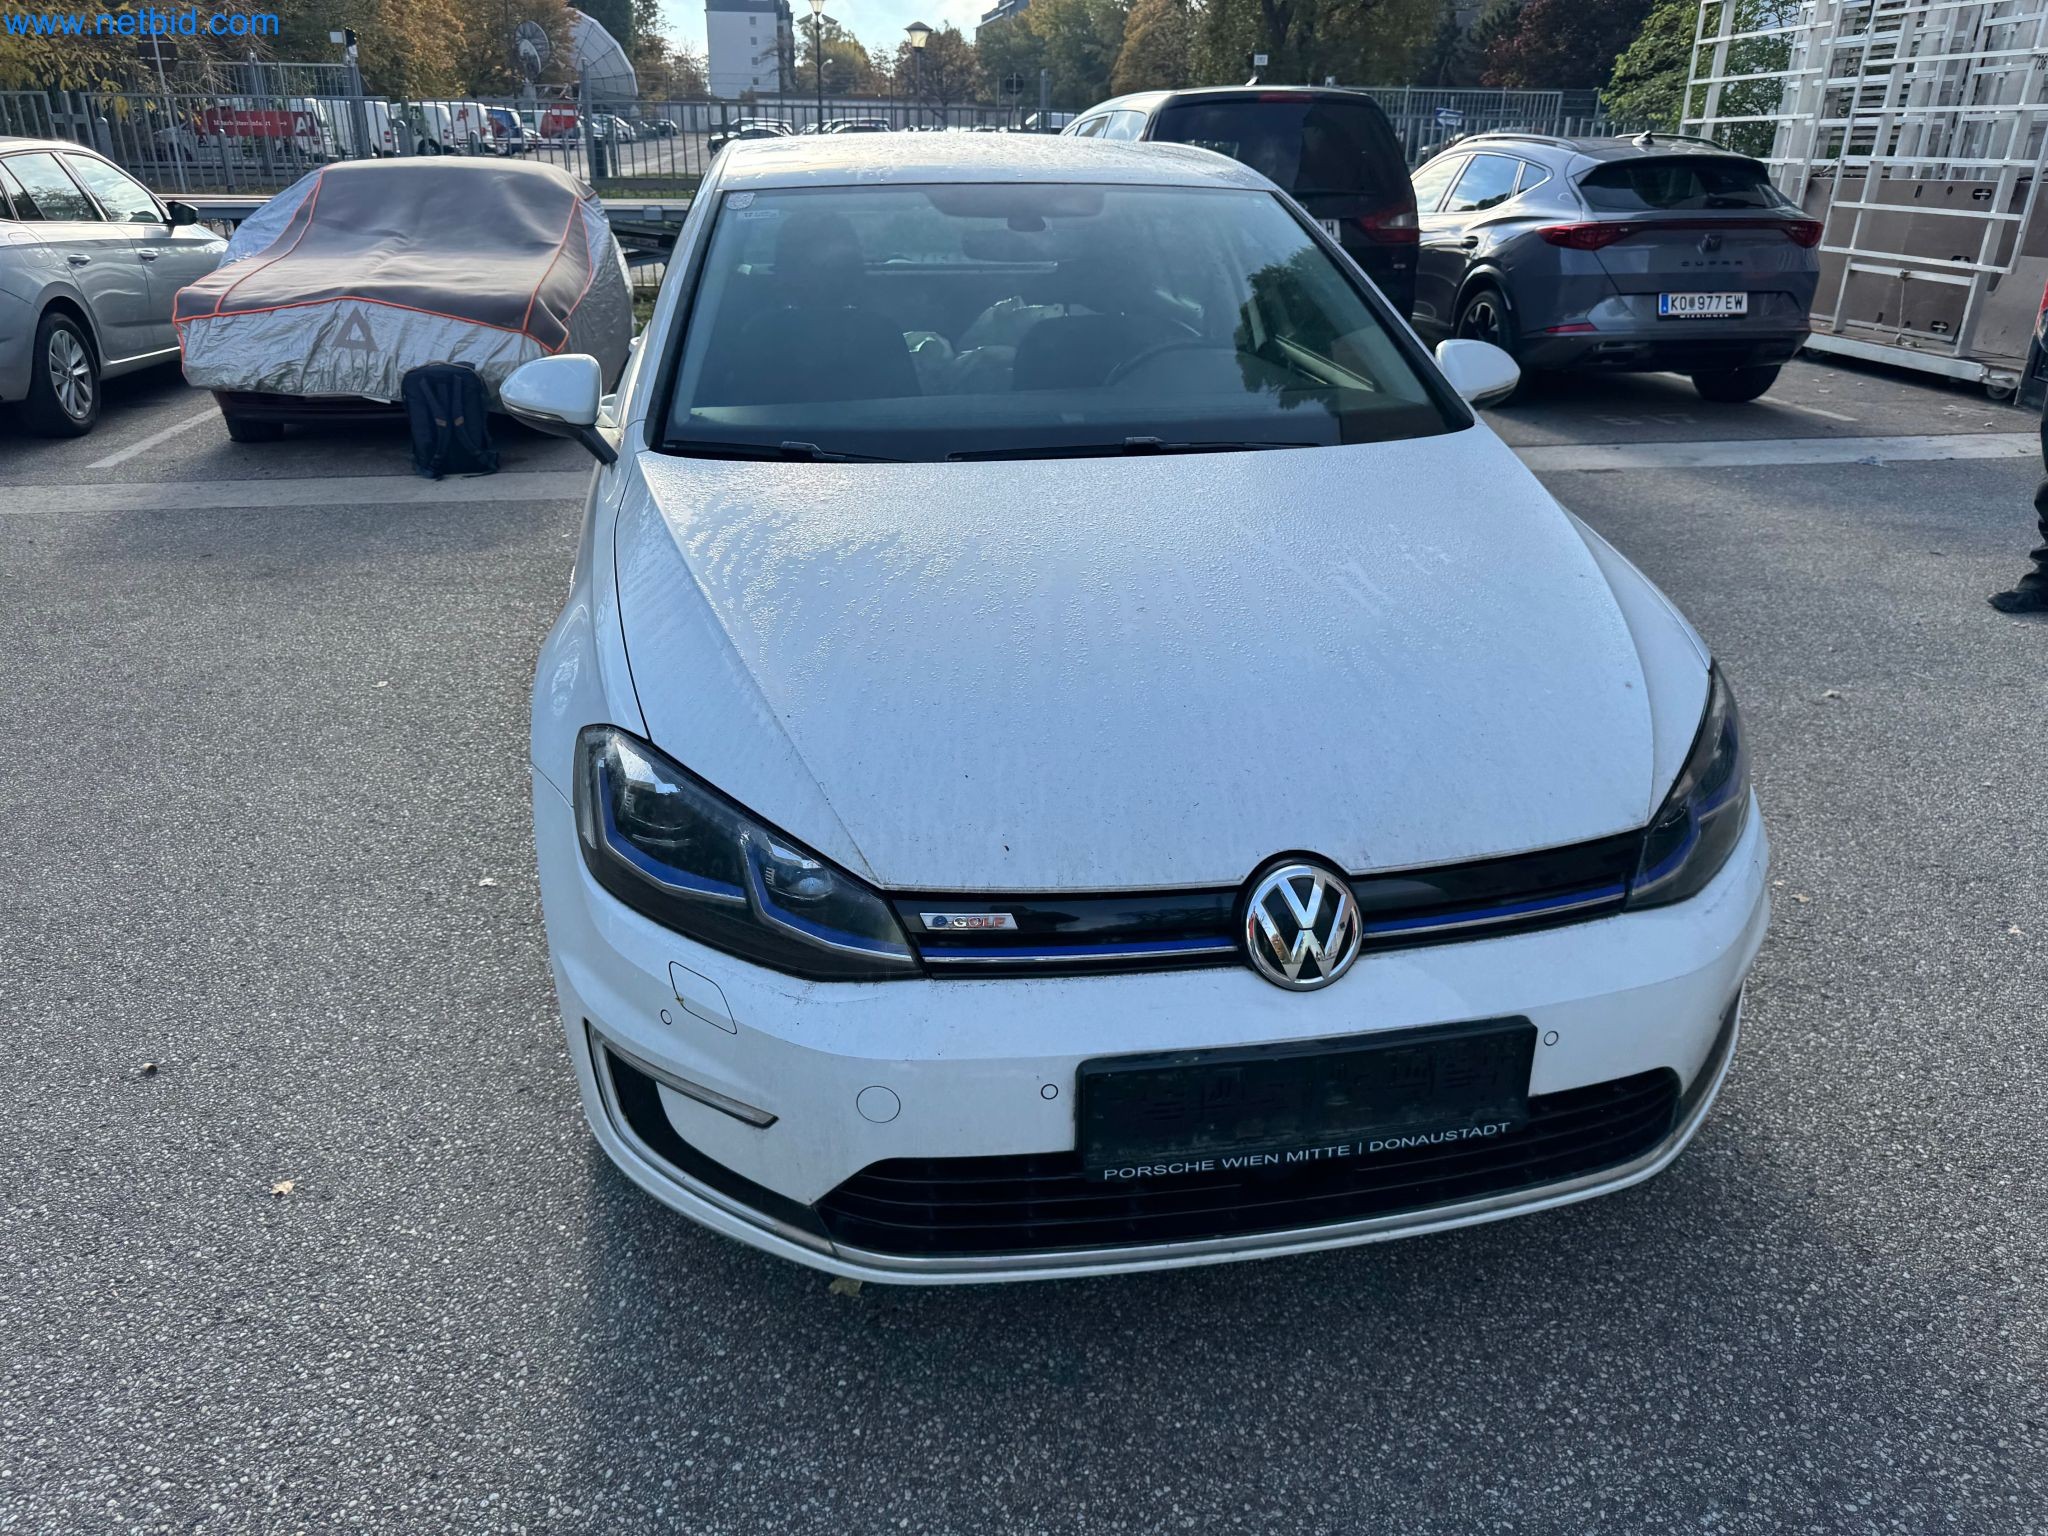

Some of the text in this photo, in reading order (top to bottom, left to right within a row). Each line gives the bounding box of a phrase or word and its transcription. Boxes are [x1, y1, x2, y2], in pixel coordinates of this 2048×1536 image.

[1670, 295, 1744, 311] KO 977 EW
[1103, 1160, 1215, 1181] PORSCHE
[1222, 1153, 1279, 1168] WIEN
[1286, 1144, 1350, 1163] MITTE
[1369, 1121, 1511, 1153] DONAUSTADT
